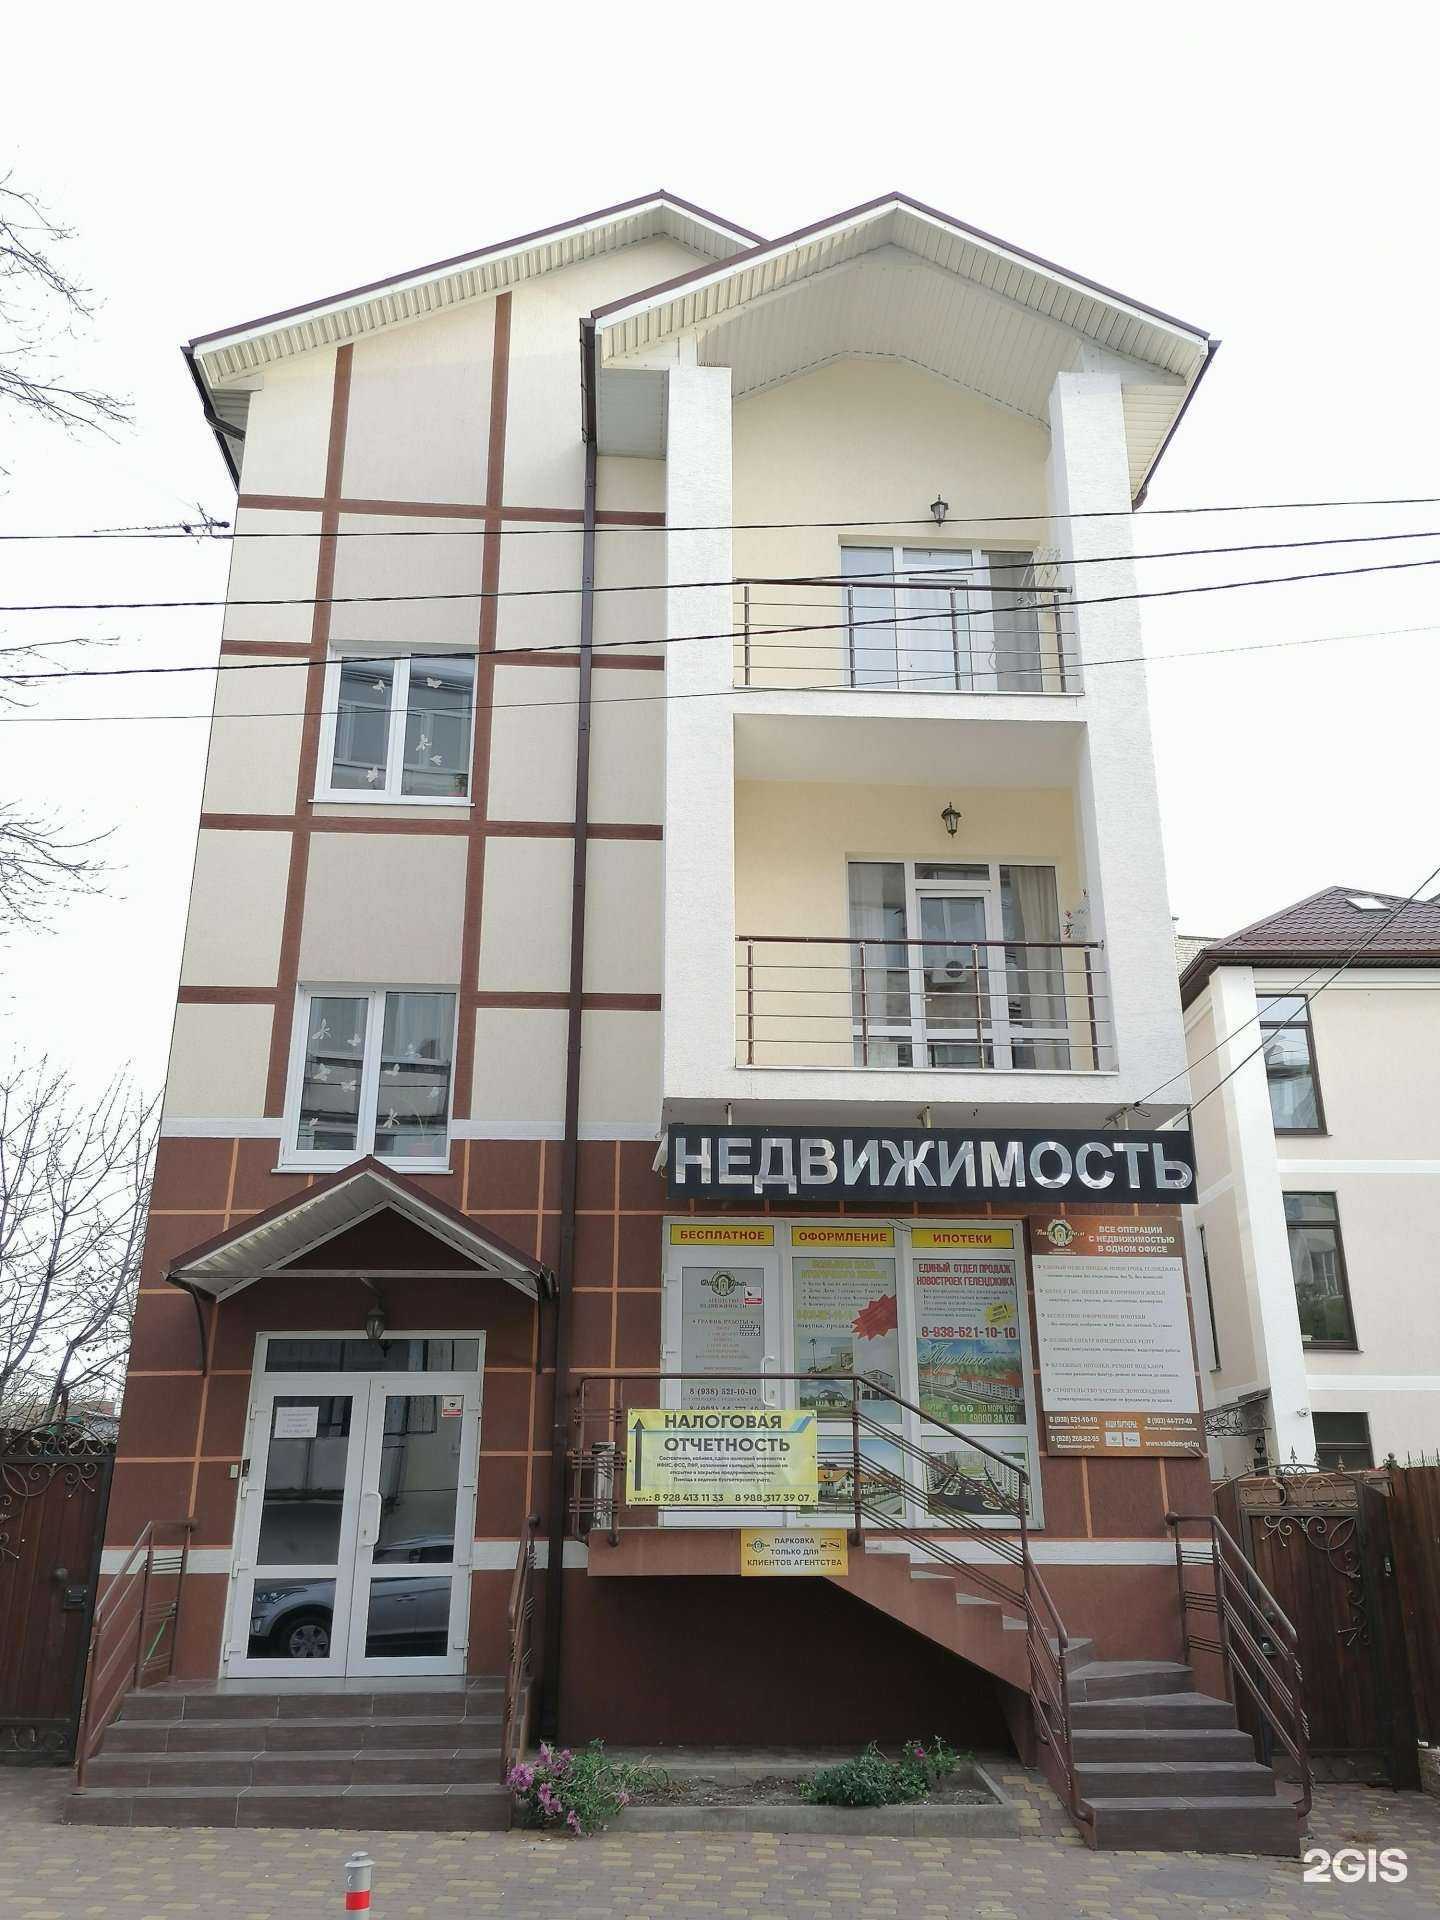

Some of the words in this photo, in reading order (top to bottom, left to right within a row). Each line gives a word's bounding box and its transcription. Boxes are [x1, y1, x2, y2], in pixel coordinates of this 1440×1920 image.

[674, 1137, 1193, 1194] НЕДВИЖИМОСТЬ
[680, 1230, 765, 1242] БЕСПЛАТНОЕ
[1117, 1226, 1163, 1235] ОПЕРАЦИИ
[799, 1231, 887, 1243] ОФОРМЛЕНИЕ
[933, 1233, 992, 1244] ИПОТЕКИ
[1096, 1236, 1175, 1244] НЕДВИЖИМОСТЬЮ
[1105, 1246, 1137, 1254] ОДНОМ
[1138, 1246, 1168, 1254] ОФИСЕ
[919, 1262, 951, 1273] ЕДИНЫЙ
[954, 1264, 978, 1273] ОТДЕЛ
[980, 1264, 1011, 1273] ПРОДАЖ
[664, 1414, 782, 1429] НАЛОГОВАЯ
[664, 1437, 791, 1452] ОТЧЕТНОСТЬ
[654, 1494, 660, 1502] 8
[662, 1494, 681, 1502] 928
[683, 1494, 699, 1502] 413
[702, 1494, 710, 1502] 11
[712, 1494, 724, 1502] 33
[735, 1494, 742, 1502] 8
[742, 1494, 762, 1502] 988
[764, 1494, 783, 1502] 317
[784, 1494, 796, 1502] 39
[798, 1494, 810, 1502] 07
